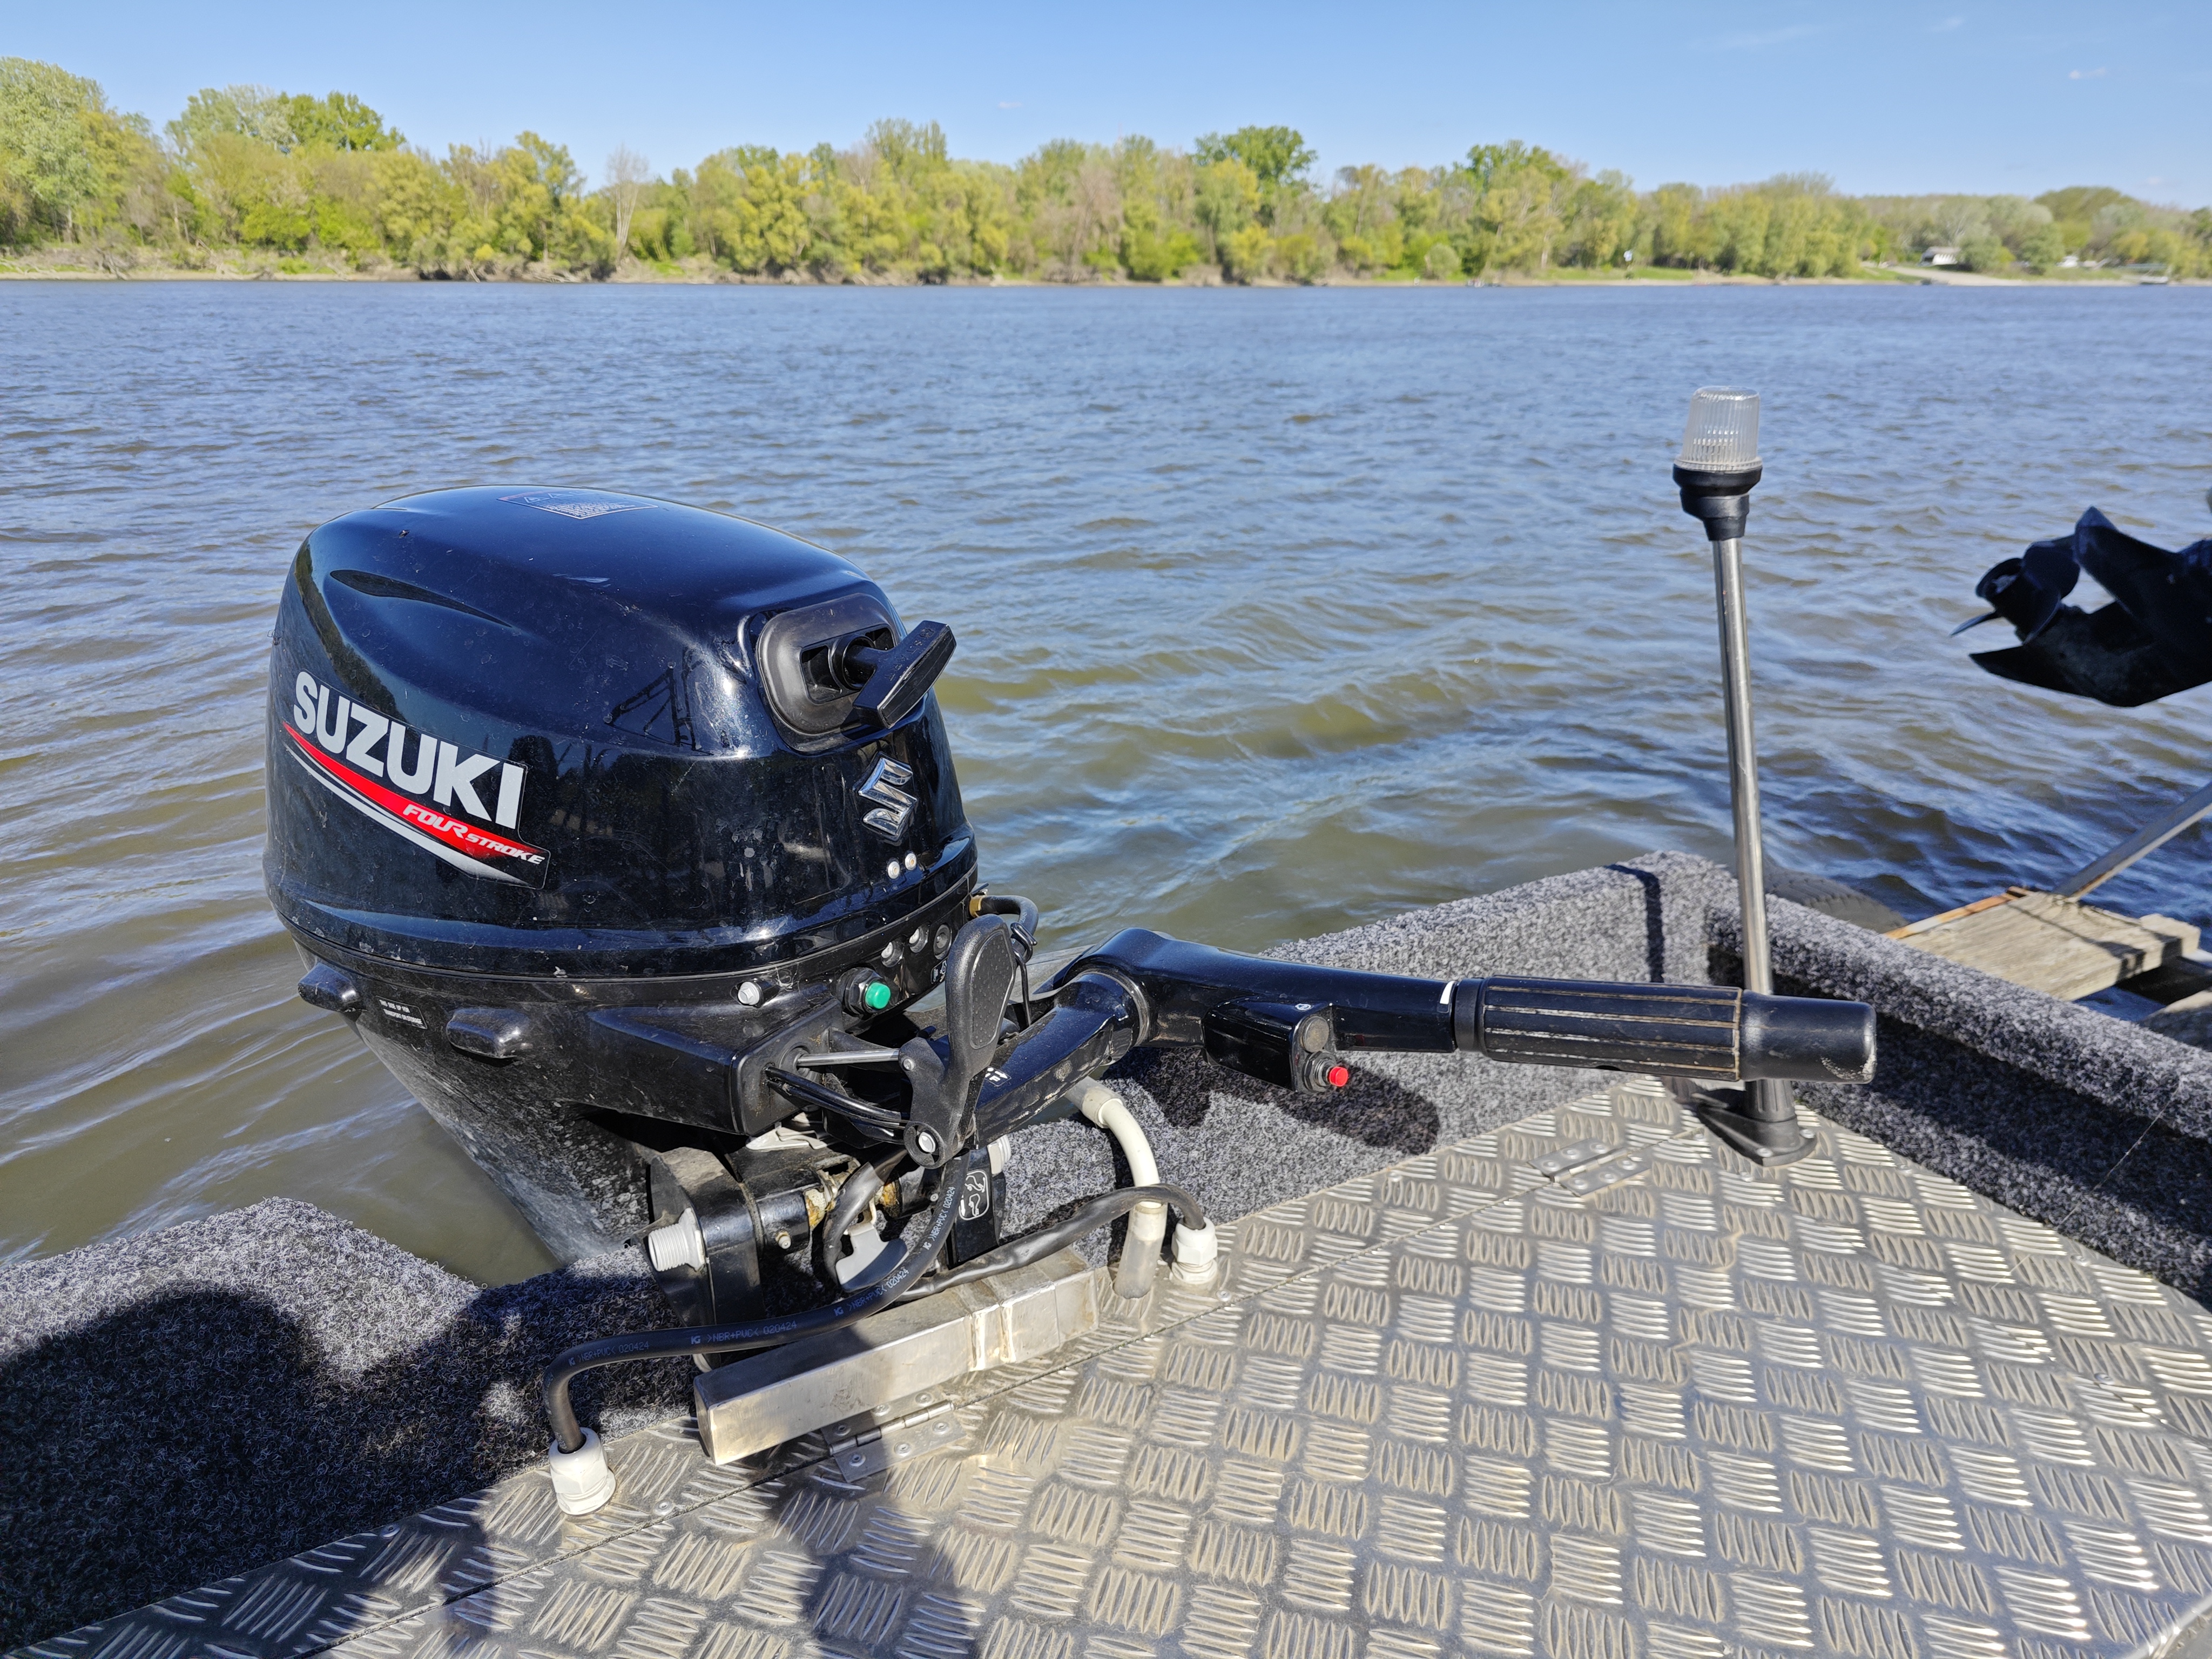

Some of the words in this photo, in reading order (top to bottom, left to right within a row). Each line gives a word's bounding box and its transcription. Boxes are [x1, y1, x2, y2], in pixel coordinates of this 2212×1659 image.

[293, 671, 524, 830] SUZUKI
[403, 804, 468, 839] FOUR
[465, 833, 545, 865] STROKE
[886, 1268, 909, 1289] 020424
[763, 1320, 797, 1335] 020424
[619, 1341, 650, 1353] 020424
